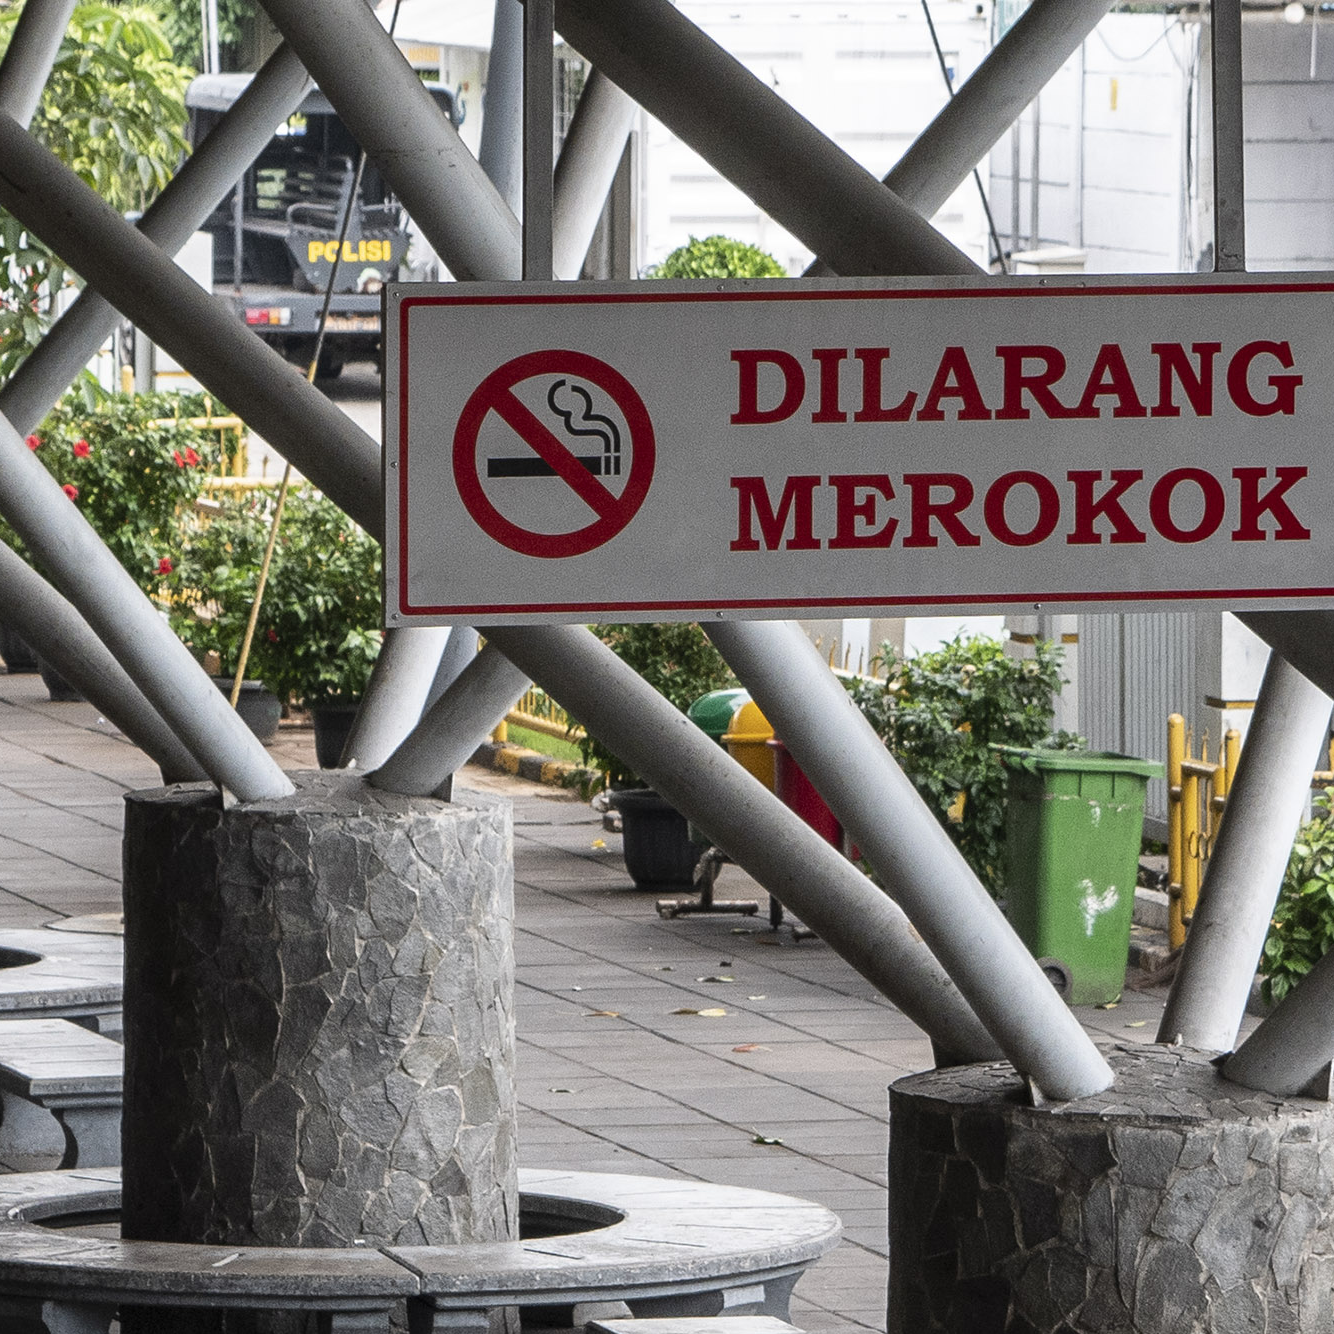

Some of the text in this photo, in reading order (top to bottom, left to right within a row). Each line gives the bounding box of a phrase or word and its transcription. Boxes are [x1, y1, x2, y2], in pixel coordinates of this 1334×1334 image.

[308, 240, 391, 262] POLISI
[730, 341, 1303, 424] DILARANG
[730, 466, 1311, 551] MEROKOK
